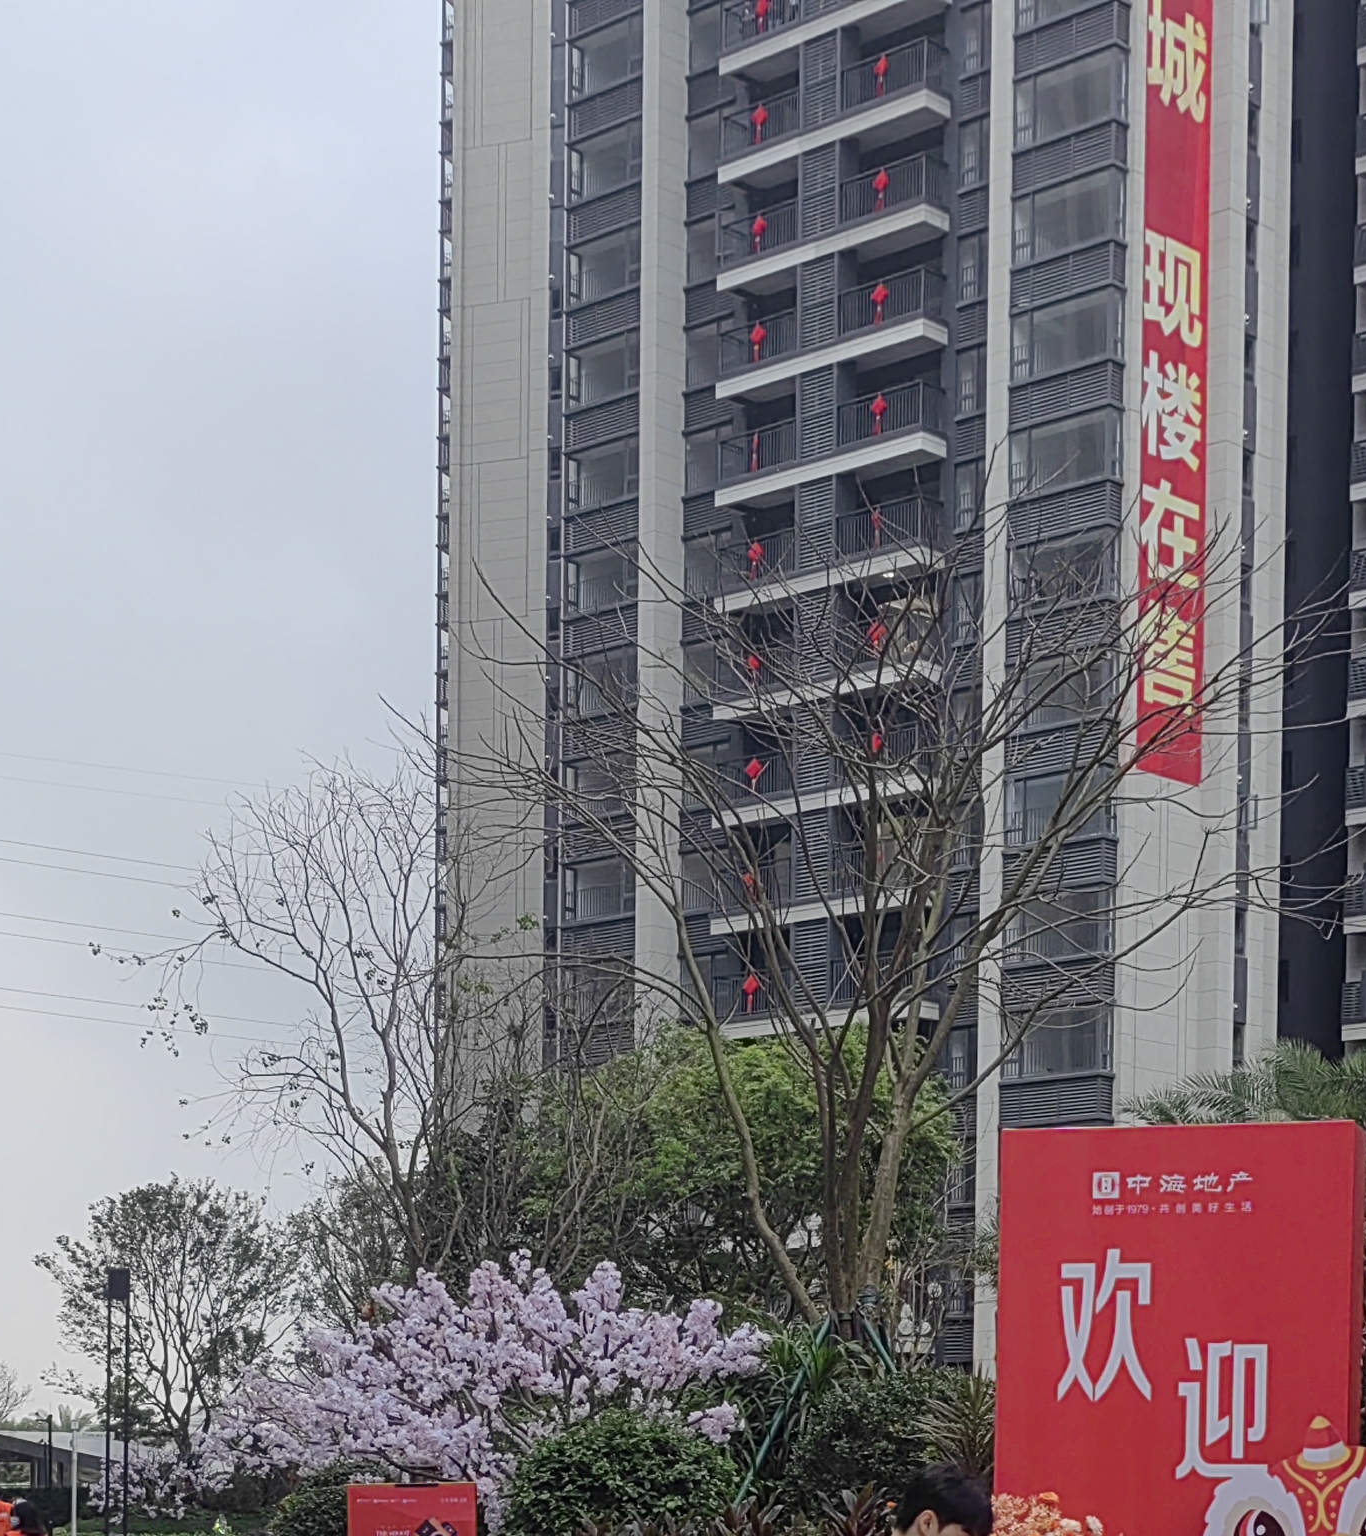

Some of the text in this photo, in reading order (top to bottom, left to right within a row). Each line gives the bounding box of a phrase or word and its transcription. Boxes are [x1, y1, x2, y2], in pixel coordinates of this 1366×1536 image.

[1138, 227, 1202, 716] 现楼在售
[1126, 1171, 1253, 1195] 中海地产
[1057, 1248, 1268, 1480] 欢迎
